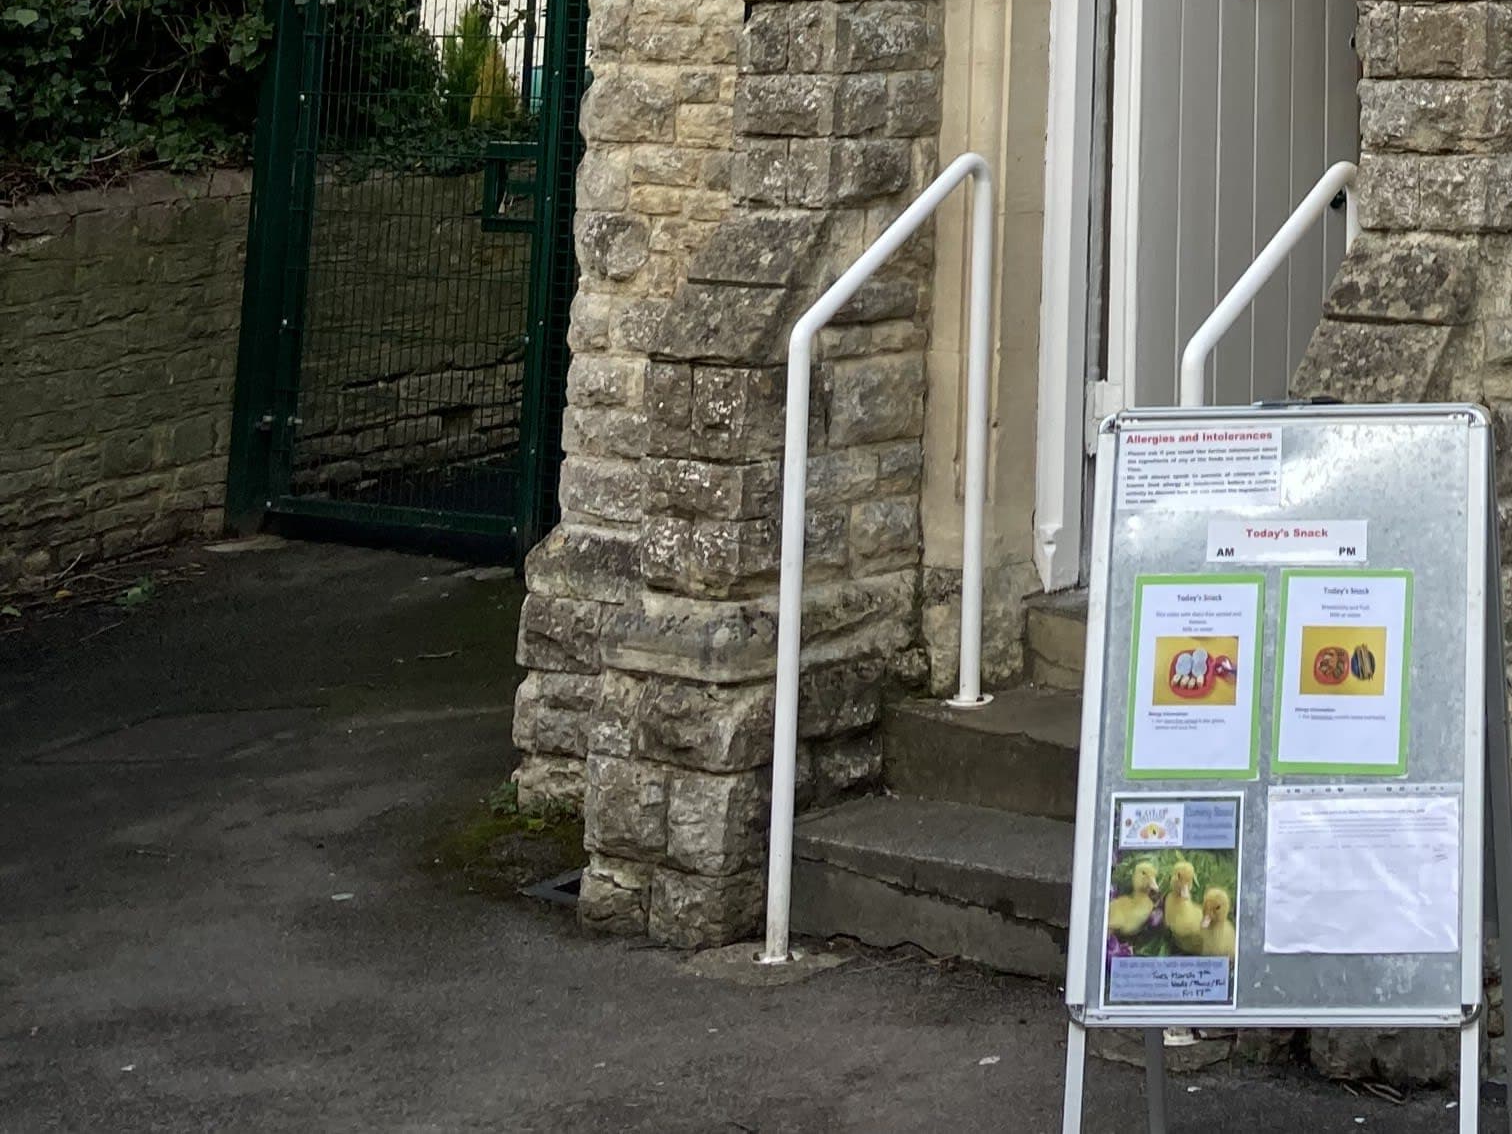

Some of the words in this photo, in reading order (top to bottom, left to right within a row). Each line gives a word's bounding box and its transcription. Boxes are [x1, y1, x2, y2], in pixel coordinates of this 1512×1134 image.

[1126, 434, 1175, 445] Allergies
[1178, 432, 1199, 443] and
[1202, 431, 1273, 442] Intolerances
[1245, 528, 1290, 540] Today's
[1293, 528, 1329, 538] Snack
[1216, 547, 1235, 557] AM
[1338, 546, 1356, 556] PM
